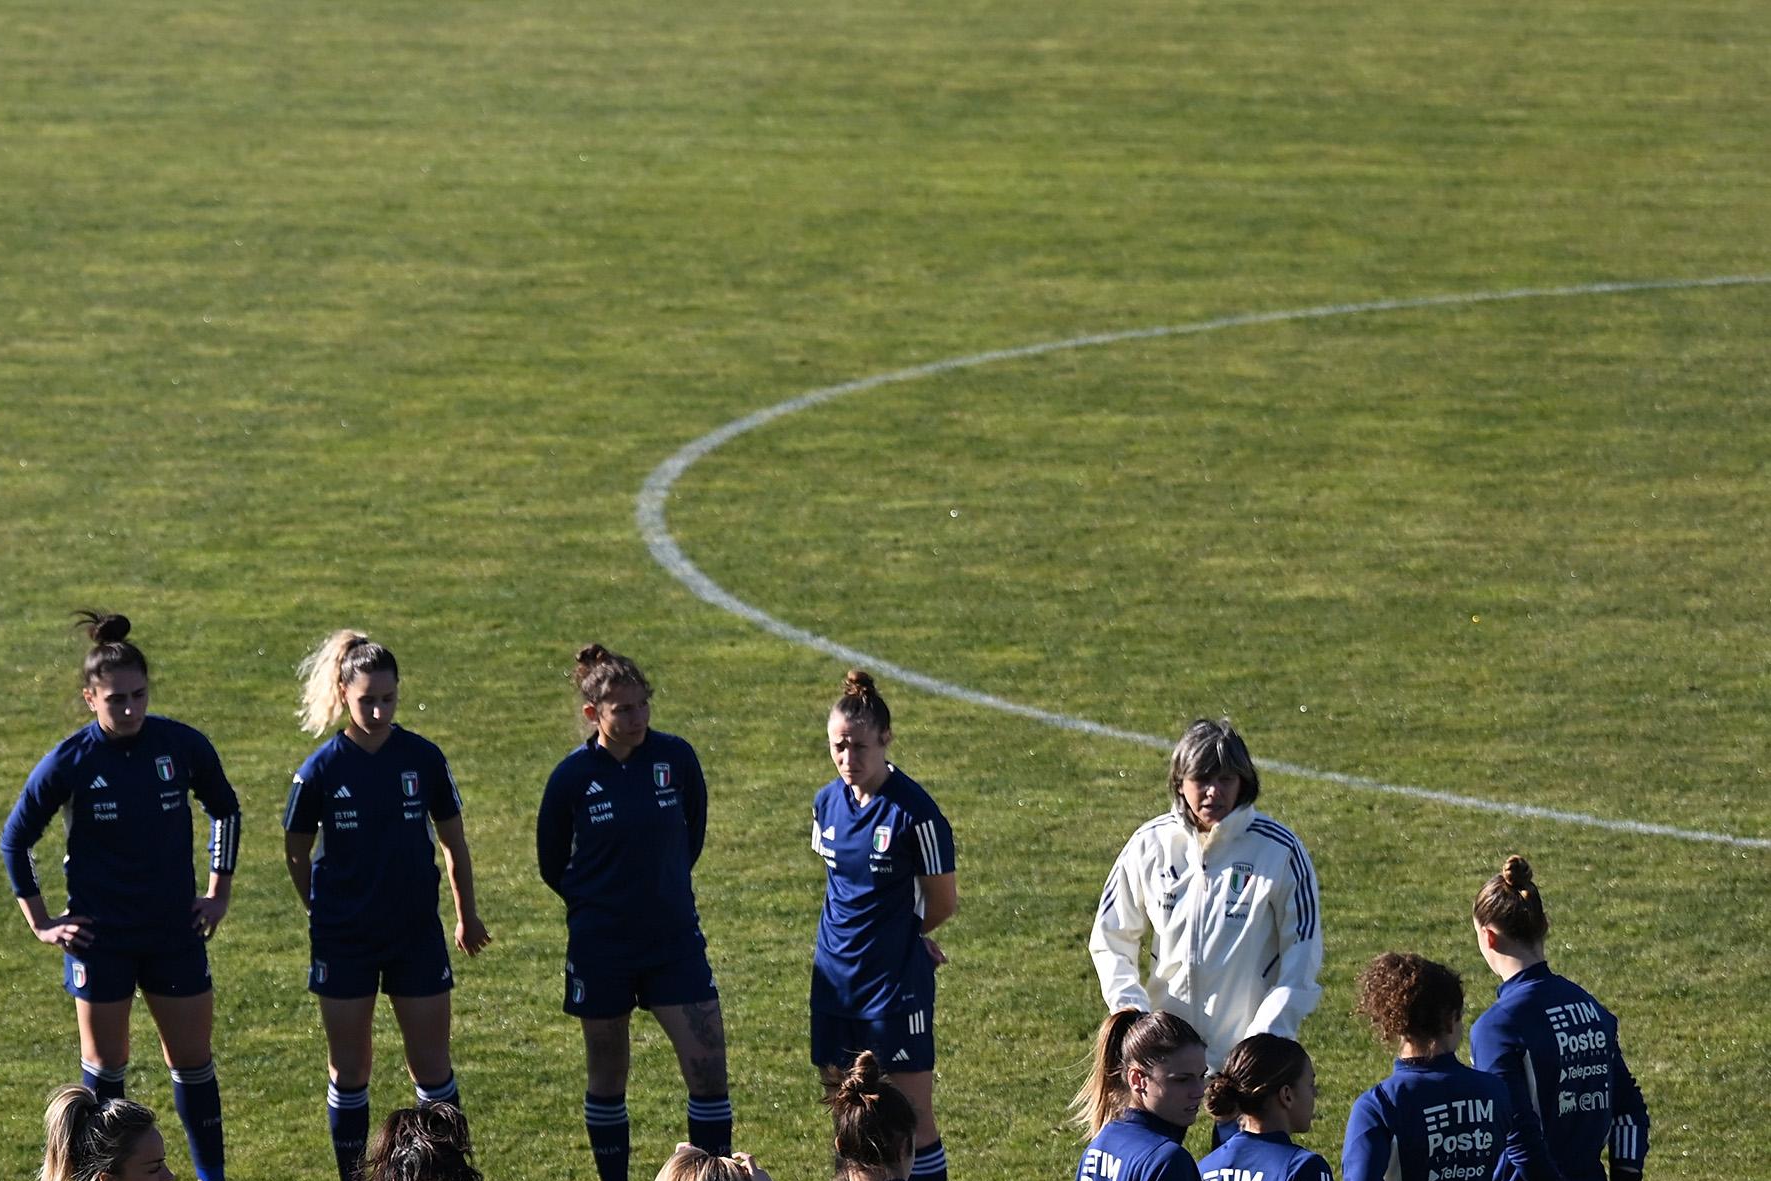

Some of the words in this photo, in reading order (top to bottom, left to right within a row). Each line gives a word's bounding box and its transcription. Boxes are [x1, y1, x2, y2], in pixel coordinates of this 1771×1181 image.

[1564, 1002, 1601, 1025] TIM
[1555, 1028, 1607, 1056] Poste
[1568, 1063, 1608, 1080] Telepass
[1579, 1082, 1609, 1111] eni
[1451, 1100, 1493, 1124] TIM
[1428, 1128, 1493, 1157] Poste
